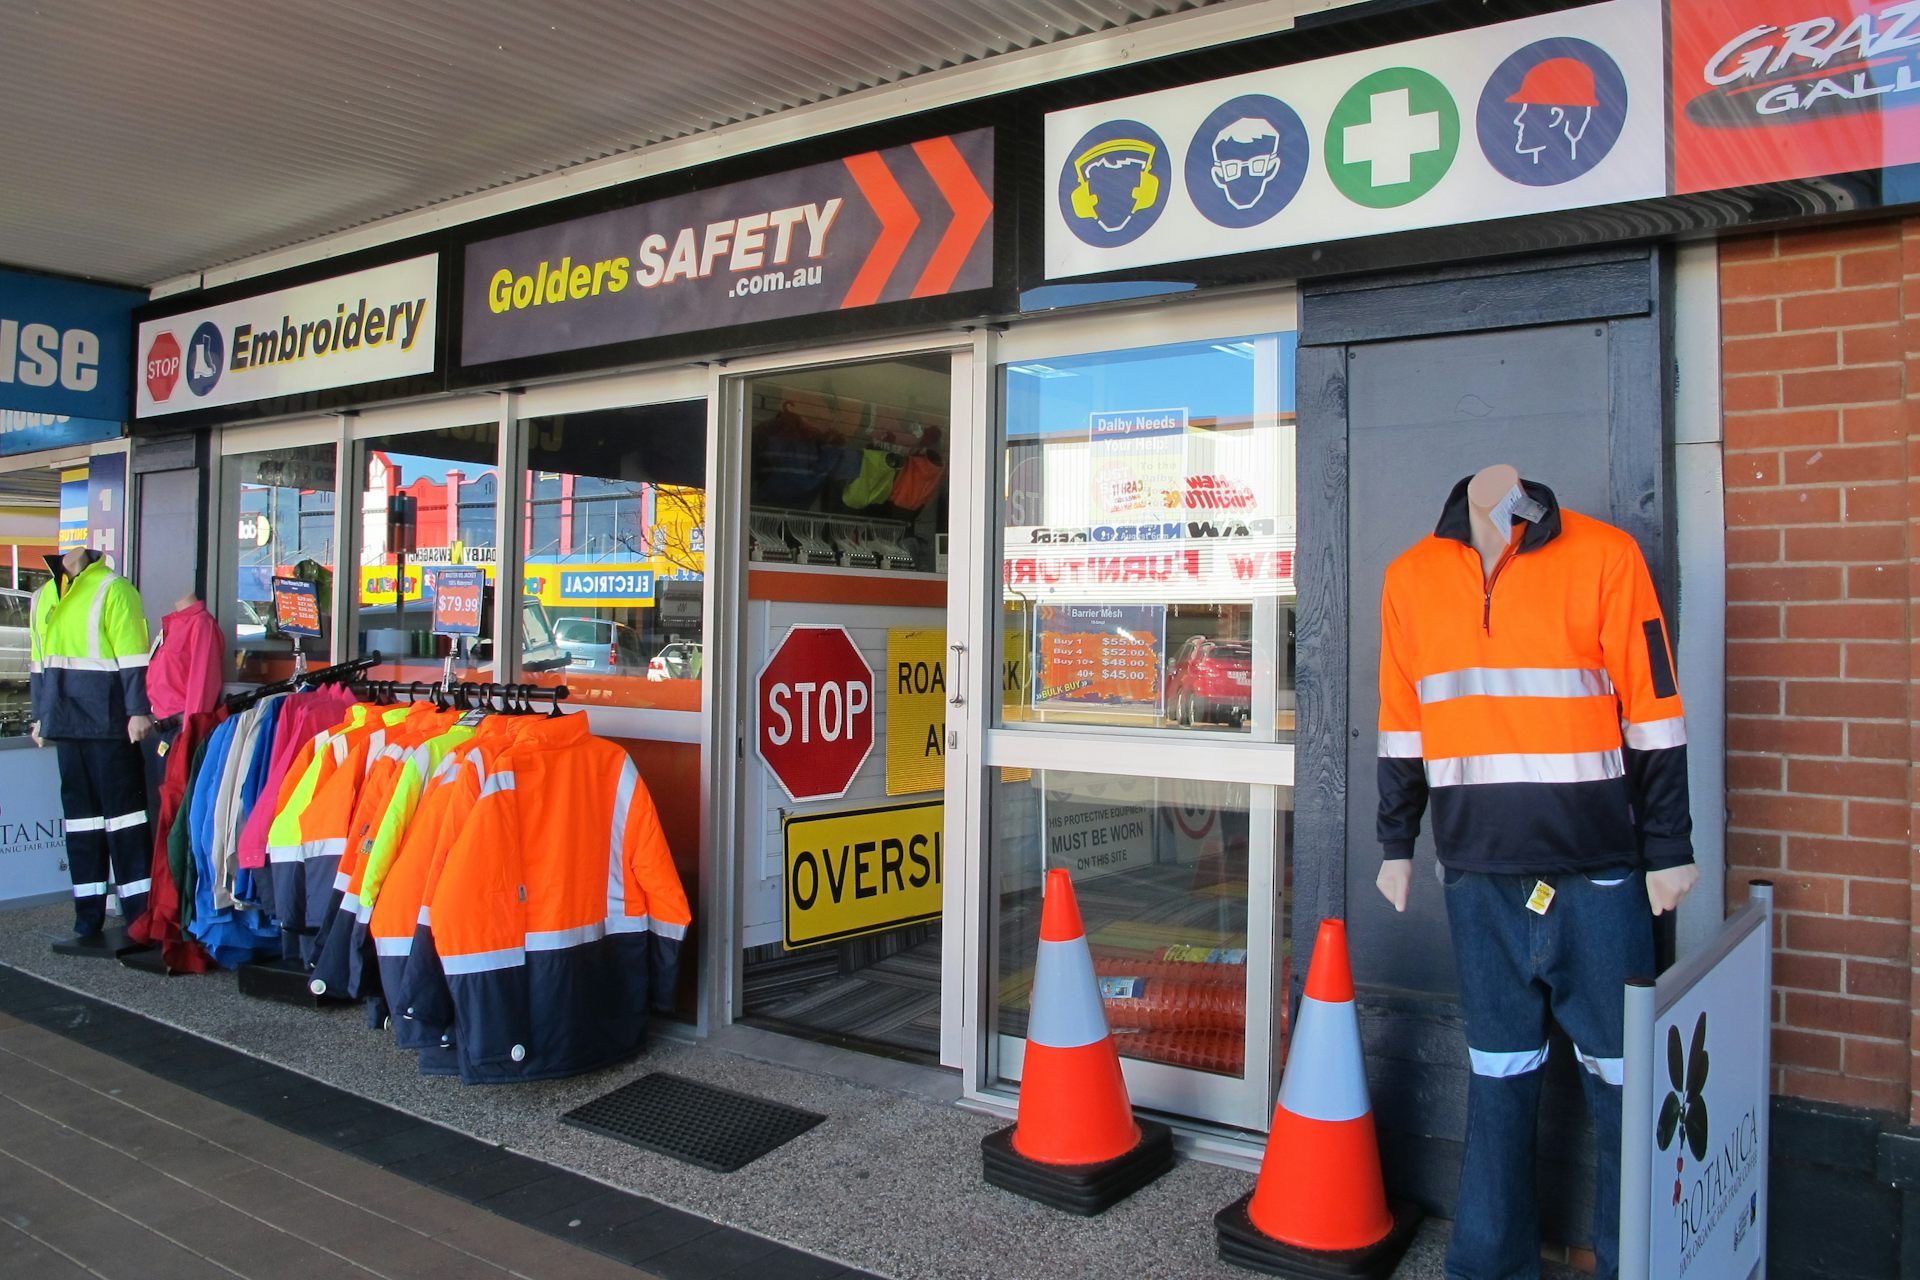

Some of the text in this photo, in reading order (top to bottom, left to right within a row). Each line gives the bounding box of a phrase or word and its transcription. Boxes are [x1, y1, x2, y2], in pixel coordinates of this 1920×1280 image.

[488, 198, 843, 313] Golders SAFETY
[728, 265, 822, 298] .com.au
[230, 297, 426, 372] Embroidery
[147, 357, 180, 380] STOP
[1098, 415, 1176, 434] Dalby Needs
[1104, 439, 1132, 452] Your
[438, 596, 479, 613] $79.99
[1072, 608, 1123, 618] Barrier Mesh
[1053, 638, 1073, 646] Buy
[1076, 670, 1094, 678] 40+
[1041, 680, 1082, 699] BULK BUY
[767, 680, 869, 746] STOP
[1064, 808, 1110, 827] PROTECTIVE
[23, 843, 43, 852] FAIR
[1051, 821, 1144, 855] MUST BE WORN
[1077, 849, 1128, 871] ON THIS SITE
[792, 831, 941, 911] OVERSI
[1679, 1104, 1758, 1254] BOTANICA
